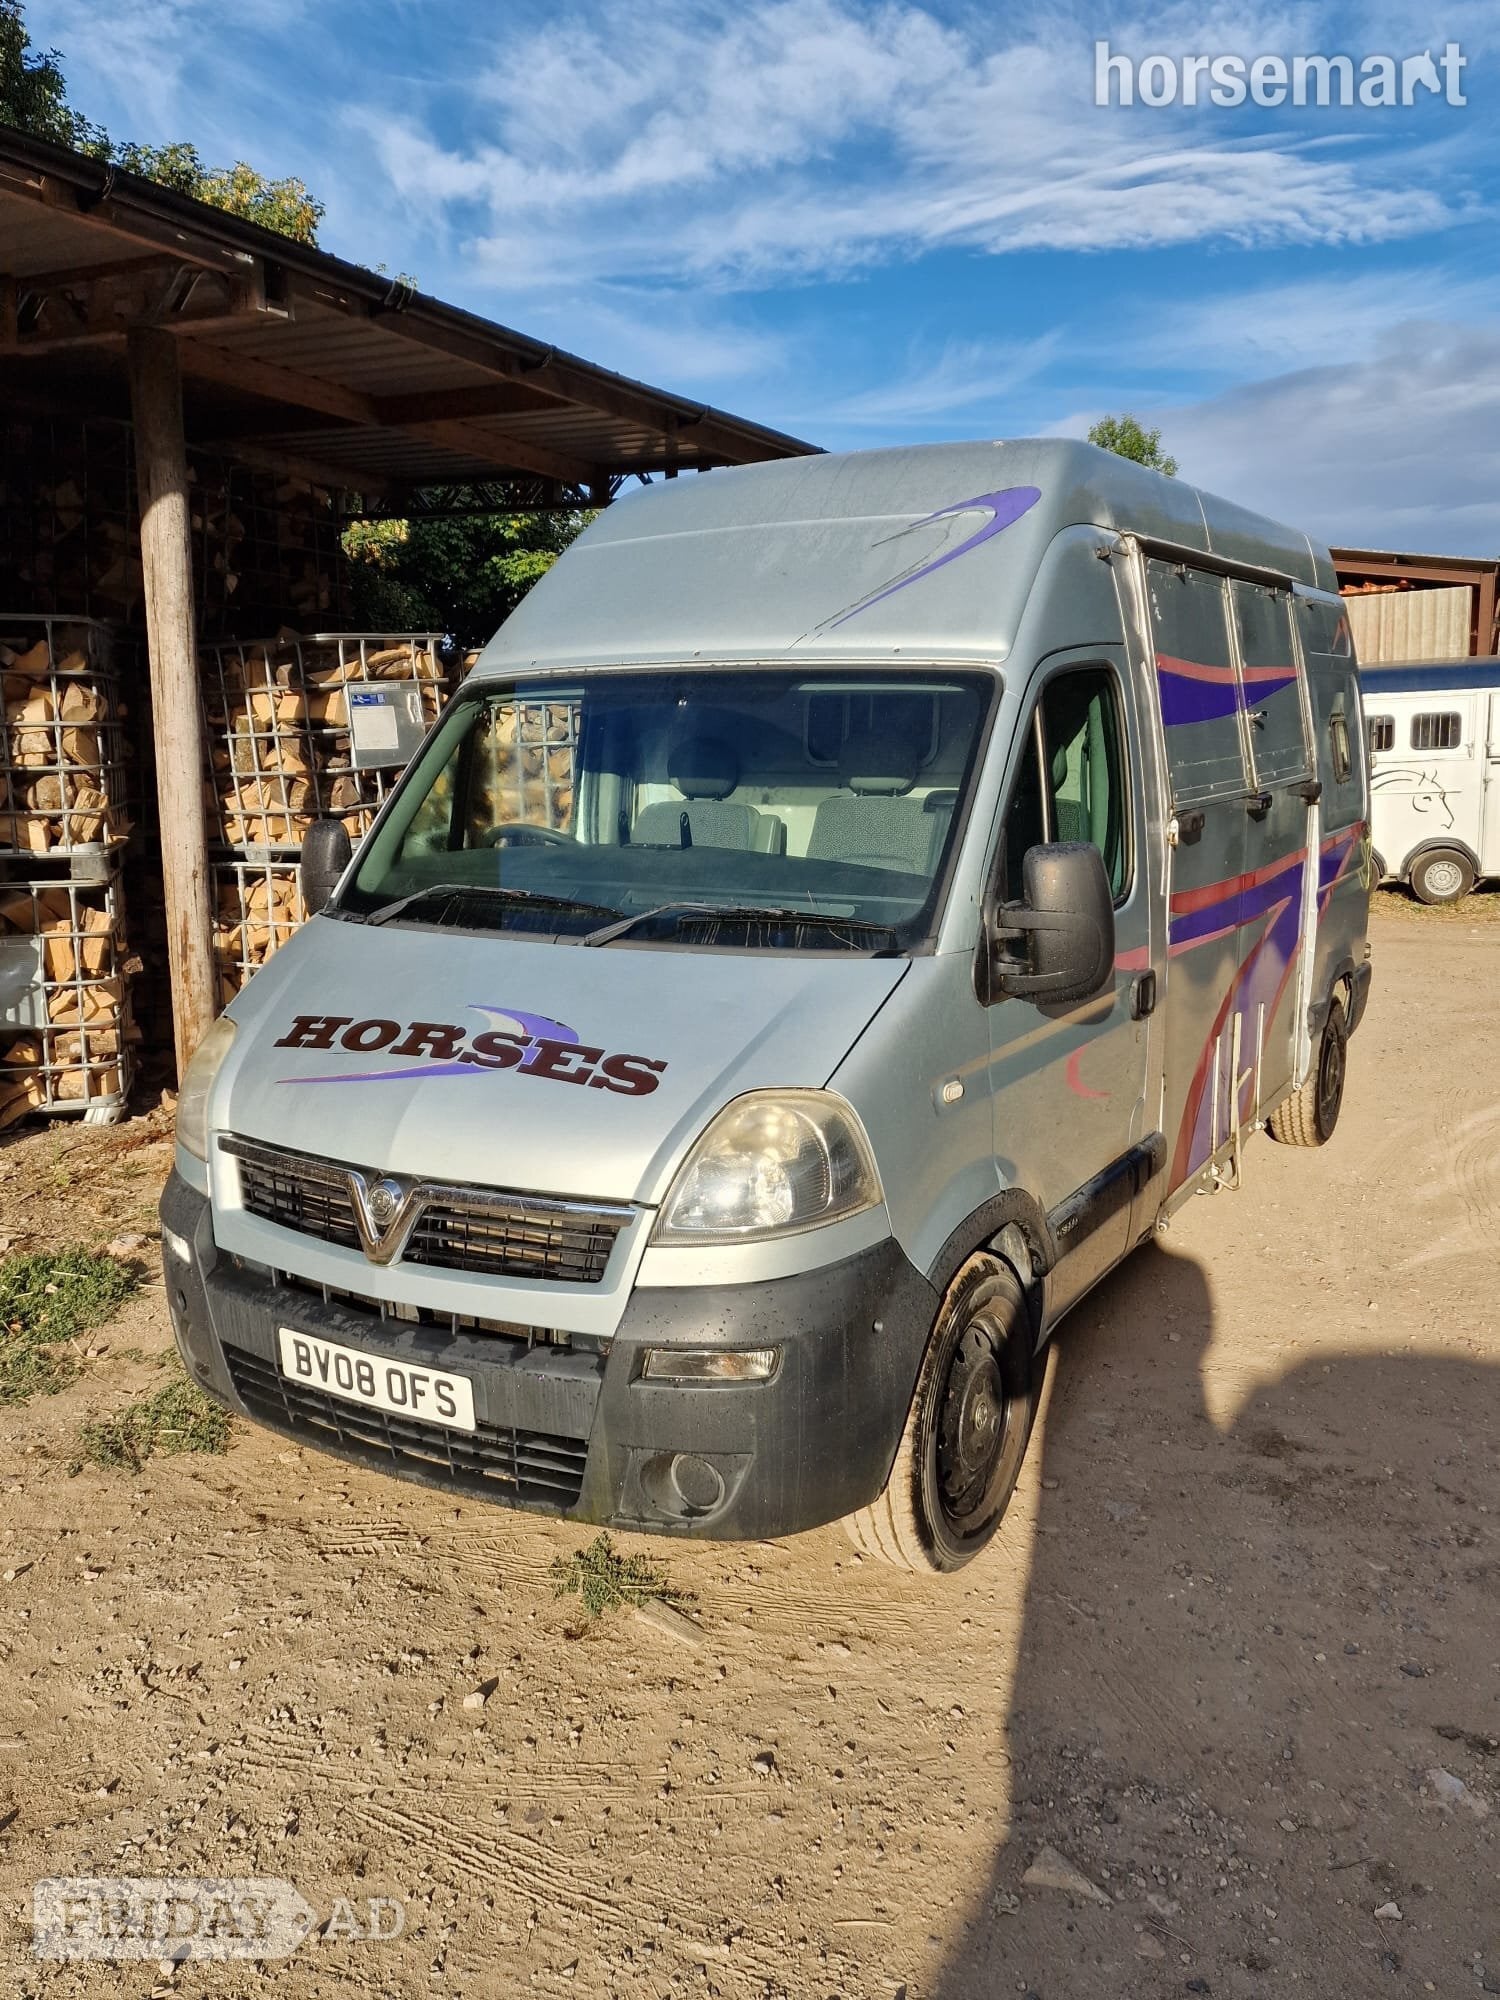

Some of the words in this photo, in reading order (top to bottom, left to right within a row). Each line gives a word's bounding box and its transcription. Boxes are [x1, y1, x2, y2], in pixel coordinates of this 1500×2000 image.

[273, 1015, 669, 1096] HORSES
[293, 1338, 376, 1398] BV08
[386, 1367, 457, 1418] OFS
